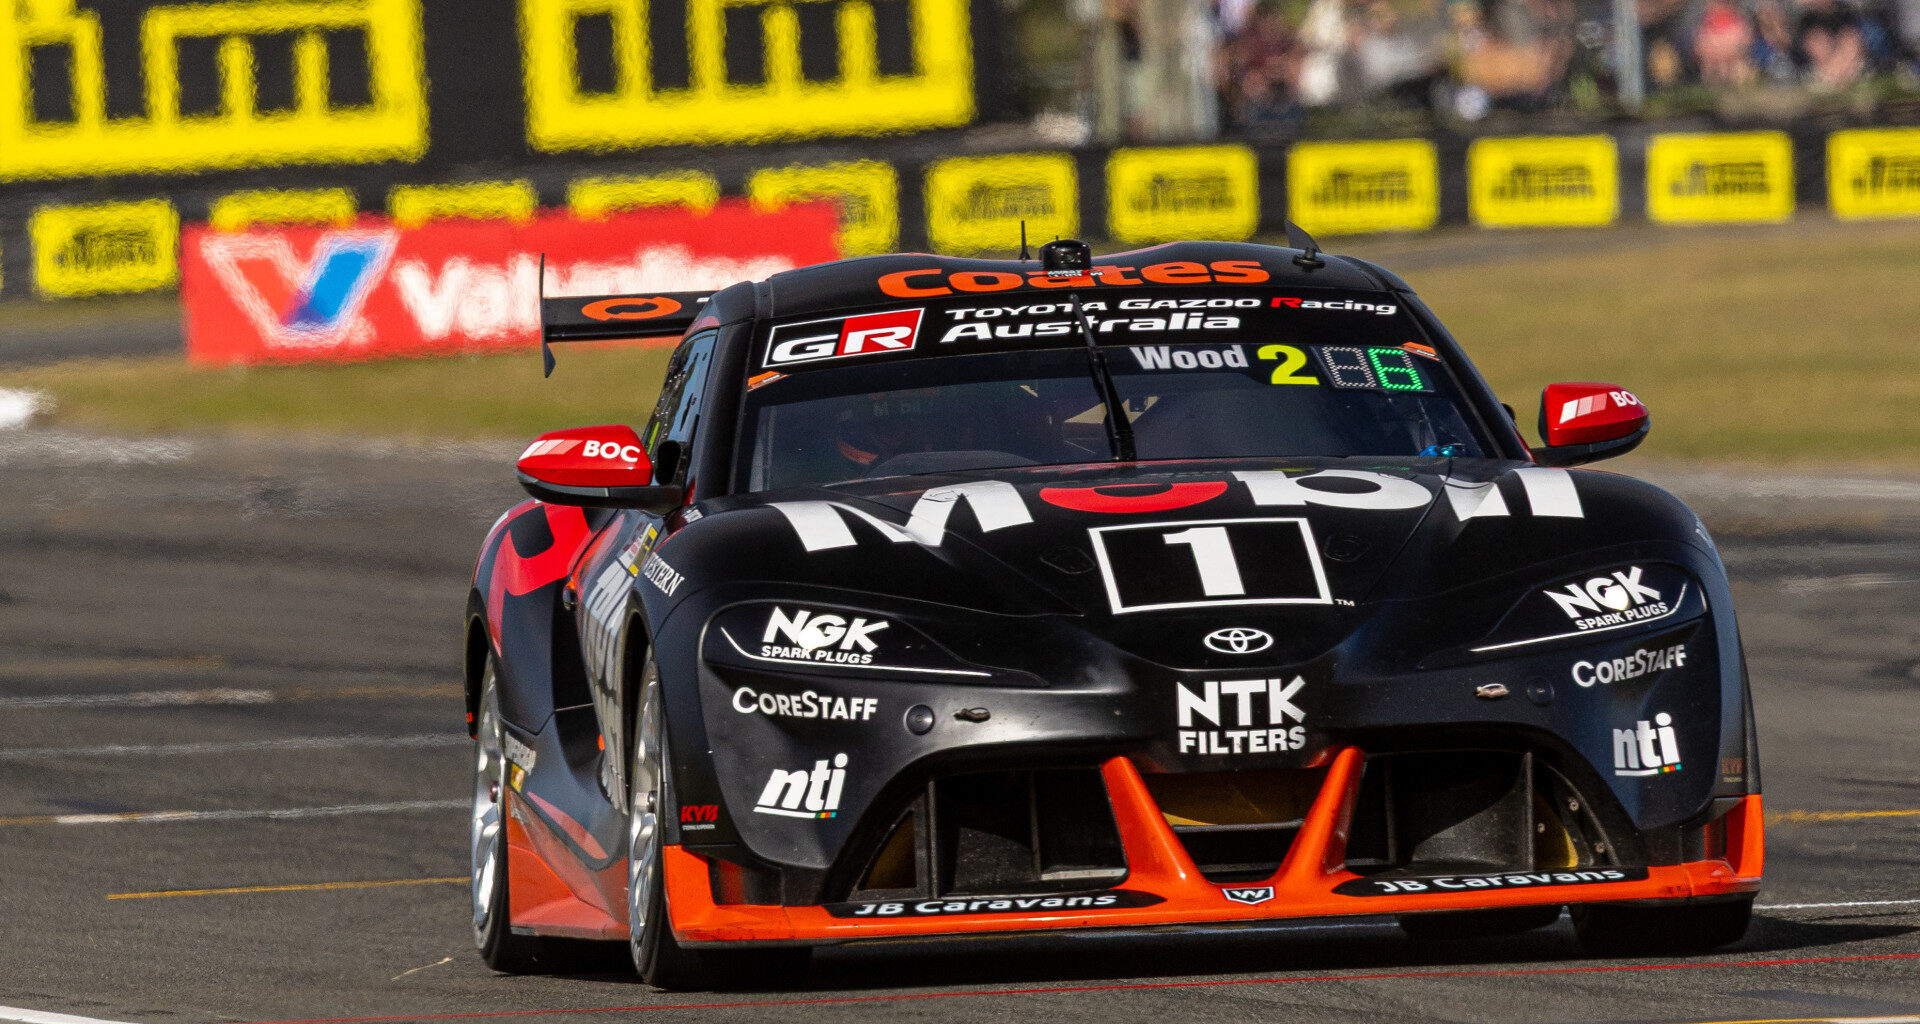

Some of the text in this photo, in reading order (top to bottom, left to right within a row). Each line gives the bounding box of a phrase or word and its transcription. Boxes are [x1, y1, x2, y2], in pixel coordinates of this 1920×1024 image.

[878, 260, 1270, 298] Coates
[945, 297, 1397, 321] TOYOTA GAZOO Racing
[771, 325, 913, 362] GR
[940, 312, 1240, 344] Australia
[1129, 344, 1249, 370] Wood
[1257, 344, 1320, 386] 2
[582, 439, 641, 464] BOC
[767, 467, 1585, 552] Mobil
[1163, 526, 1246, 597] 1
[1543, 565, 1661, 619] NGK
[762, 605, 890, 653] NGK
[1575, 601, 1669, 631] SPARK PLUGS
[760, 644, 874, 665] SPARK PLUGS
[1176, 674, 1306, 728] NTK
[1178, 725, 1306, 755] FILTERS
[1612, 711, 1682, 769] nti
[756, 752, 849, 812] nti
[1374, 867, 1626, 893] JB Caravans
[854, 892, 1118, 915] JB Caravans
